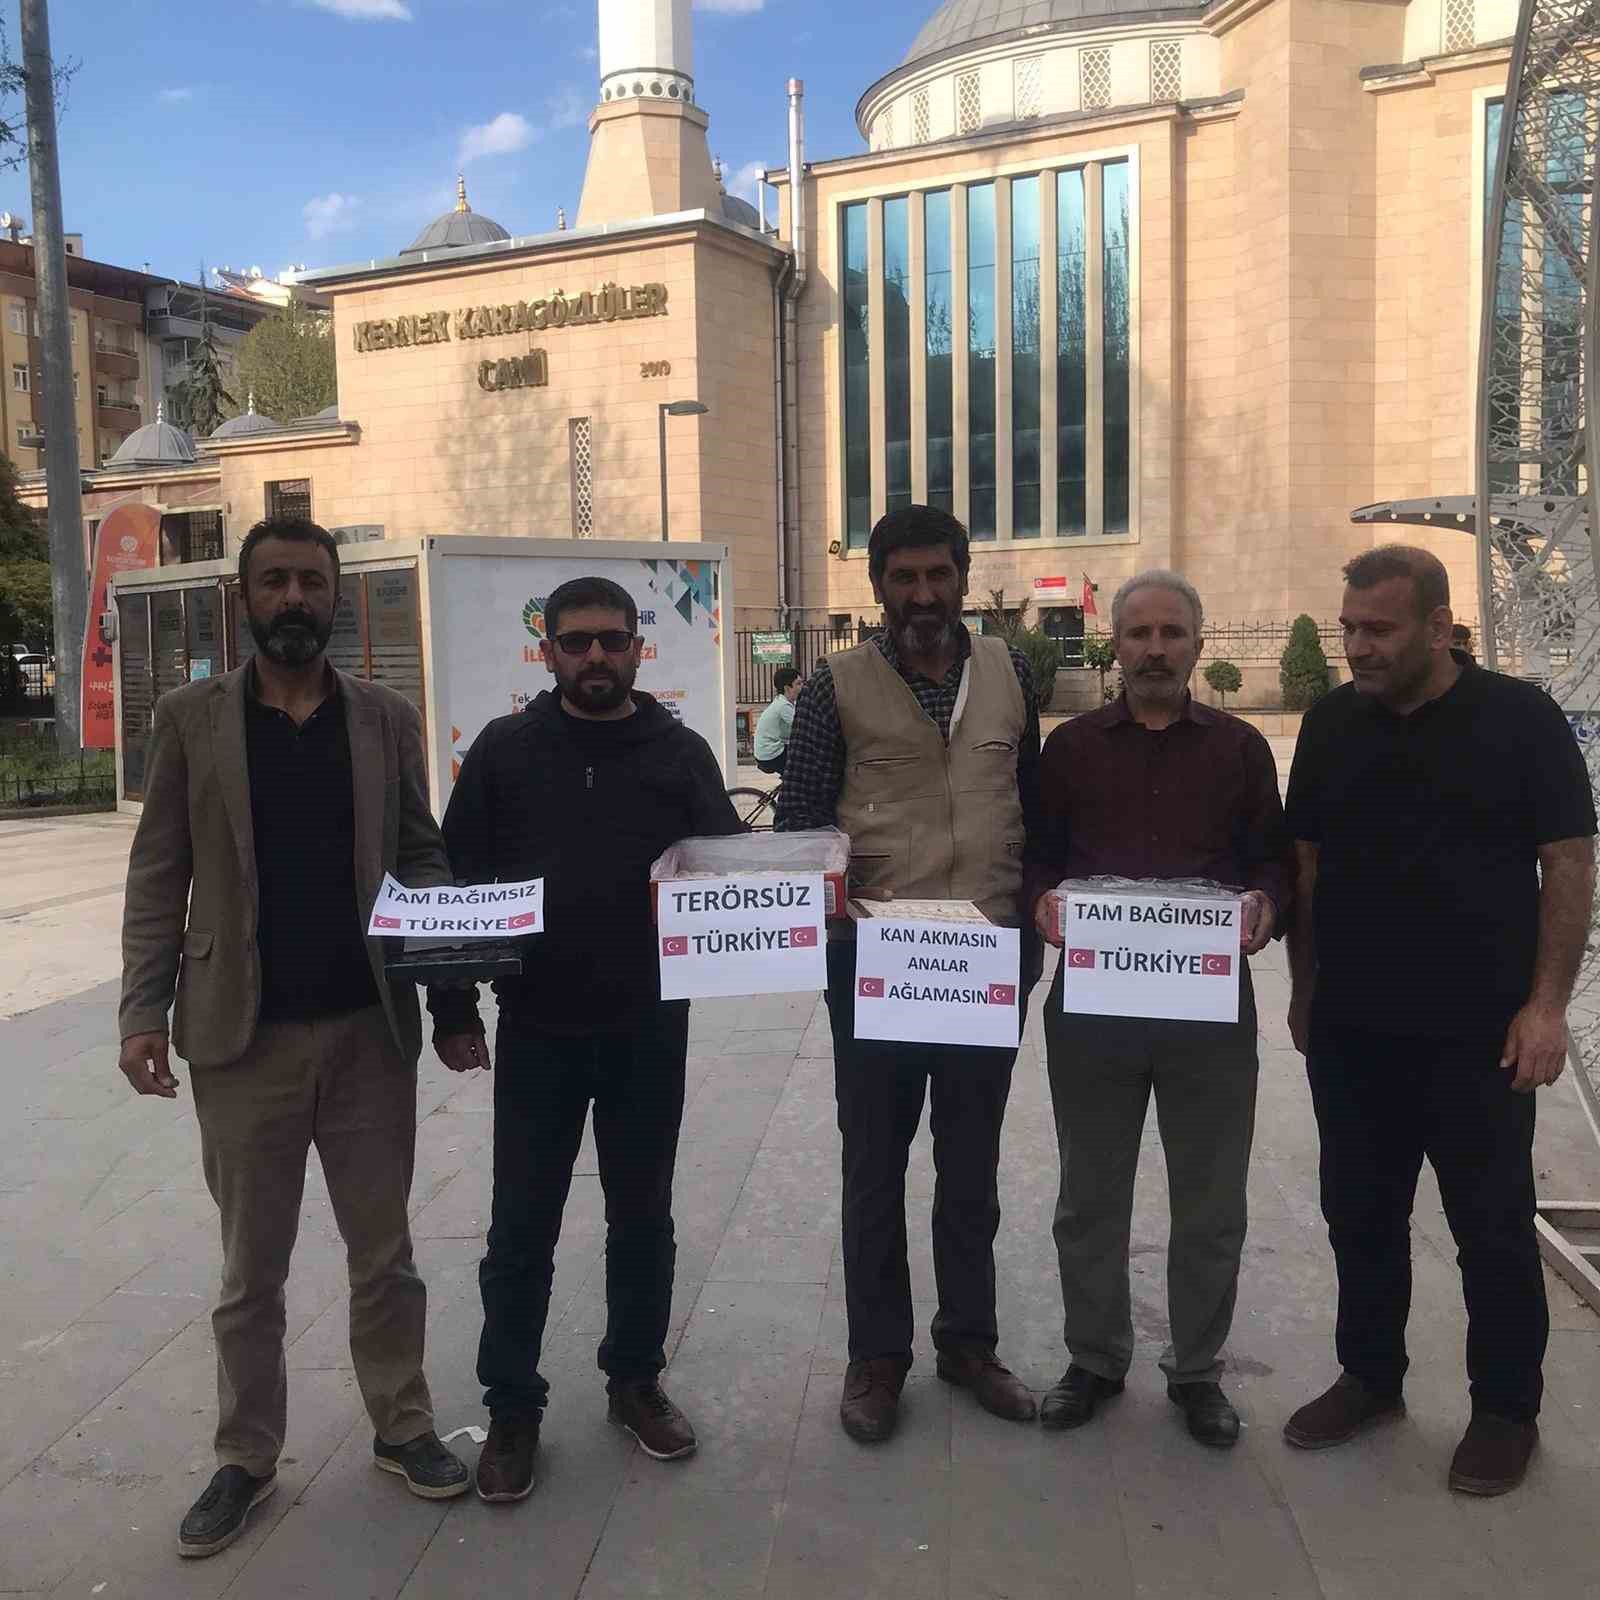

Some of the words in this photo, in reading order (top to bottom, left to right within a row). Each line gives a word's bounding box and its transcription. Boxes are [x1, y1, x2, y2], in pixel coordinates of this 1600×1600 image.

[353, 311, 450, 352] KERNEK
[455, 281, 669, 340] KARAGÖZLÜLER
[387, 883, 430, 904] TAM
[437, 884, 537, 905] BAĞIMSIZ
[672, 881, 811, 913] TERÖRSÜZ
[406, 916, 509, 931] TÜRKİYE
[1075, 903, 1122, 922] TAM
[1129, 903, 1233, 927] BAĞIMSIZ
[691, 926, 790, 955] TÜRKİYE
[880, 927, 915, 943] KAN
[919, 930, 997, 948] AKMASIN
[907, 957, 969, 973] ANALAR
[1100, 947, 1201, 975] TÜRKİYE
[888, 982, 988, 1005] AĞLAMASIN
